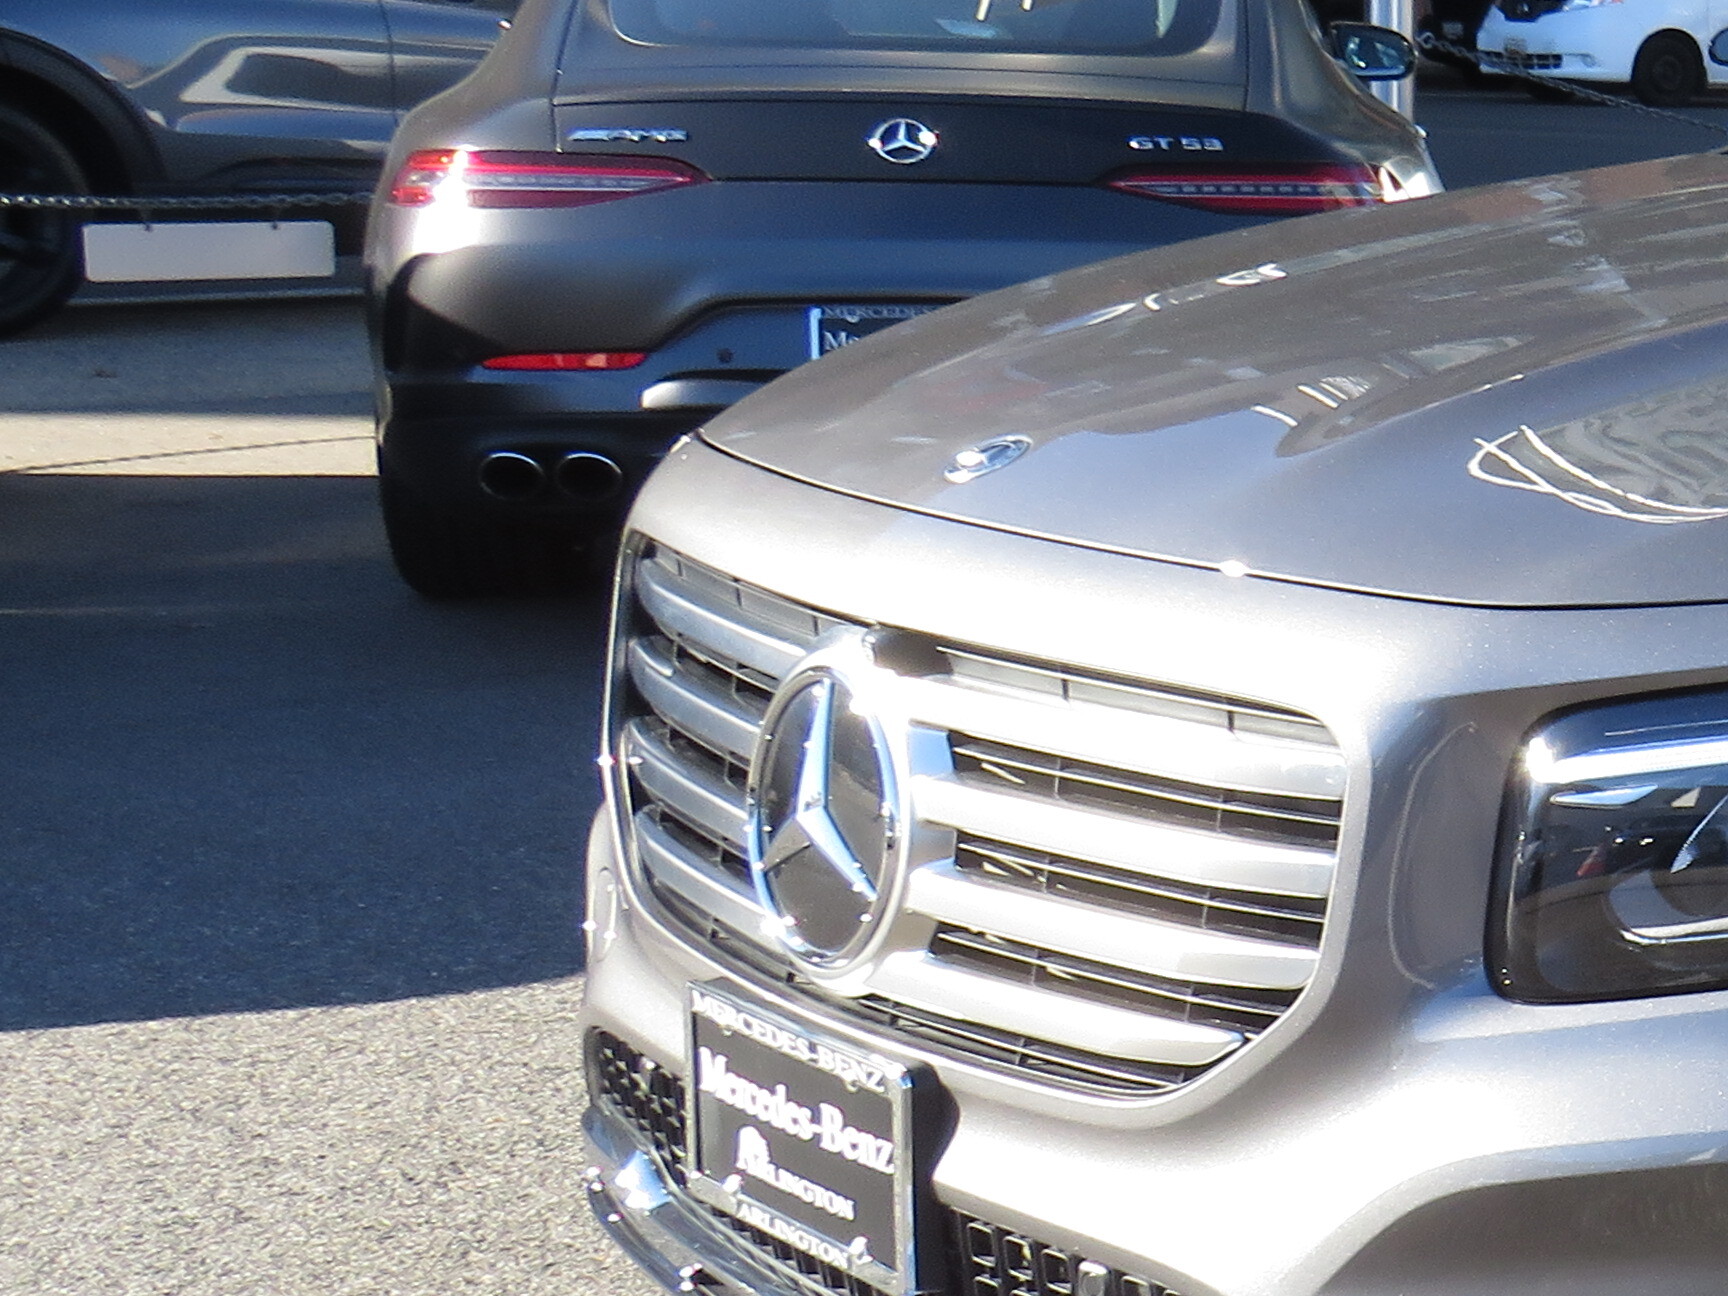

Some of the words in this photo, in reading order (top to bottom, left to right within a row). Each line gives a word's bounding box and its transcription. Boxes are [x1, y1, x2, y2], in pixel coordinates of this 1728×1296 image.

[1127, 136, 1174, 151] GT
[691, 990, 885, 1093] MERCEDES-BENZ
[699, 1045, 896, 1175] Mercedes-Benz
[736, 1144, 855, 1222] ARLINGTON
[736, 1203, 850, 1270] ARLINGTON
